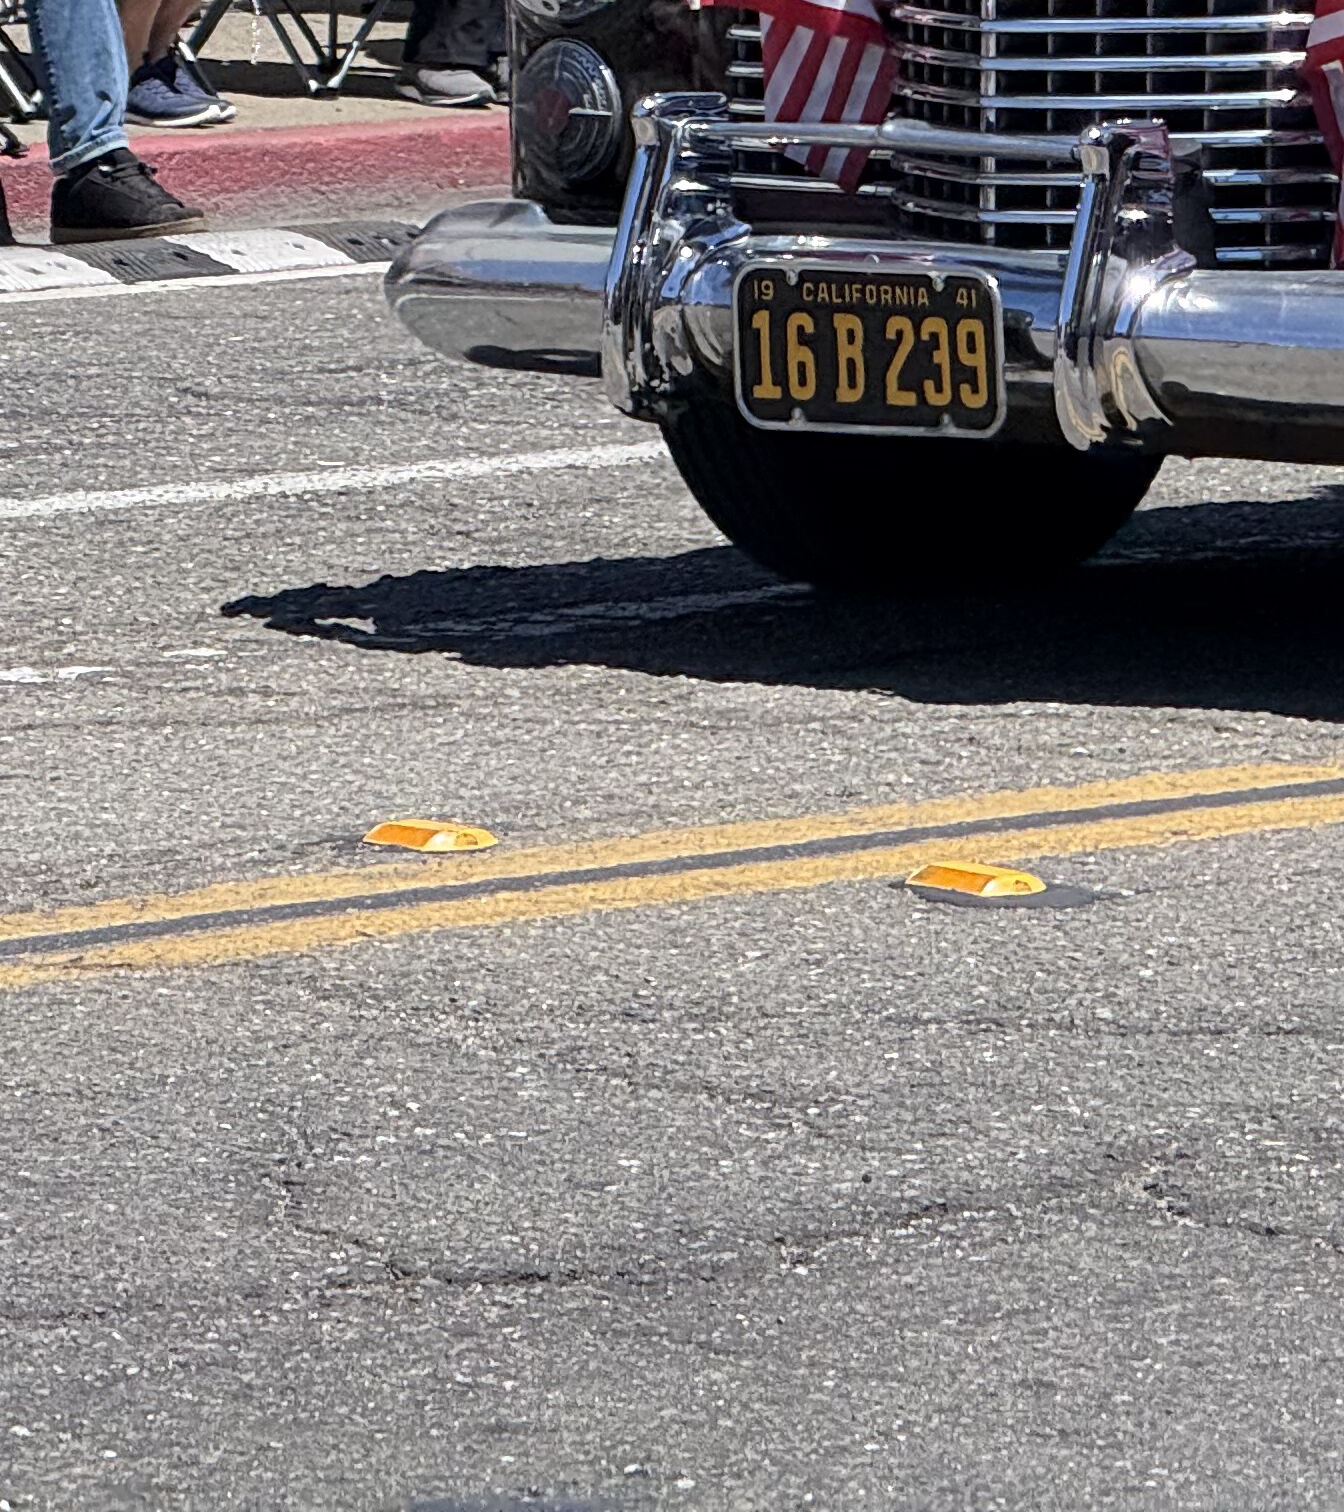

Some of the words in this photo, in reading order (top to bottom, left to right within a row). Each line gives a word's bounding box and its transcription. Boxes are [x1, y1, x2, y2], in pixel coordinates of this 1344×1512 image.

[753, 280, 774, 300] 19
[802, 282, 929, 306] CALIFORNIA
[956, 288, 977, 308] 41
[752, 309, 817, 401] 16
[832, 312, 865, 403] B
[885, 315, 989, 409] 239
